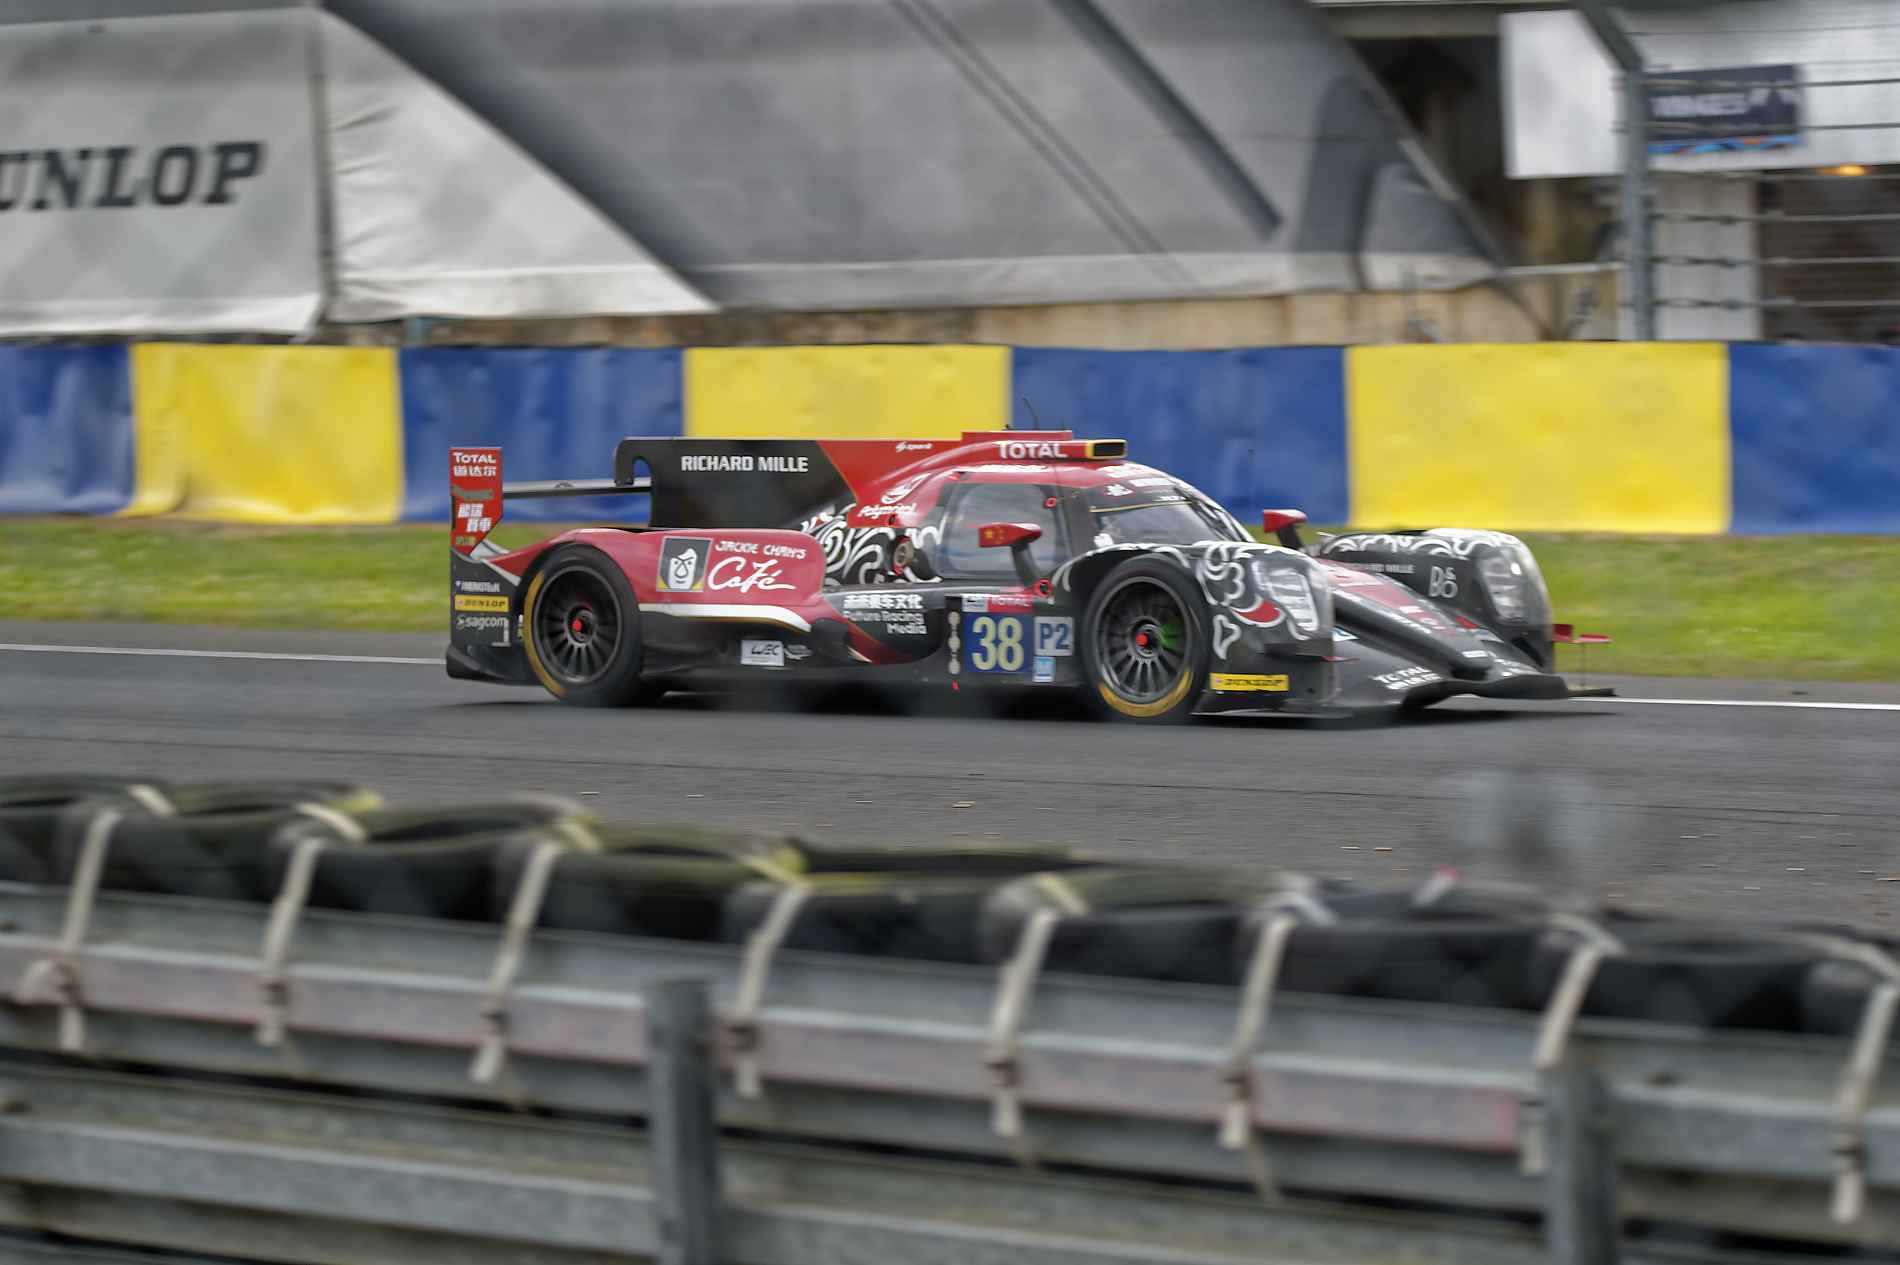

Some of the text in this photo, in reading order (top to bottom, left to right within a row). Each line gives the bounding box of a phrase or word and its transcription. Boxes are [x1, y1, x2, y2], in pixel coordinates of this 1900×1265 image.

[997, 440, 1068, 459] TOTAL
[453, 452, 497, 464] TOTAL
[681, 455, 809, 473] RICHARD MILLE
[715, 541, 759, 554] JACKIE
[708, 556, 796, 593] Café
[881, 611, 924, 625] Racing
[887, 623, 927, 635] Media
[1040, 623, 1071, 650] P2
[752, 643, 785, 656] WEC
[972, 616, 1025, 672] 38
